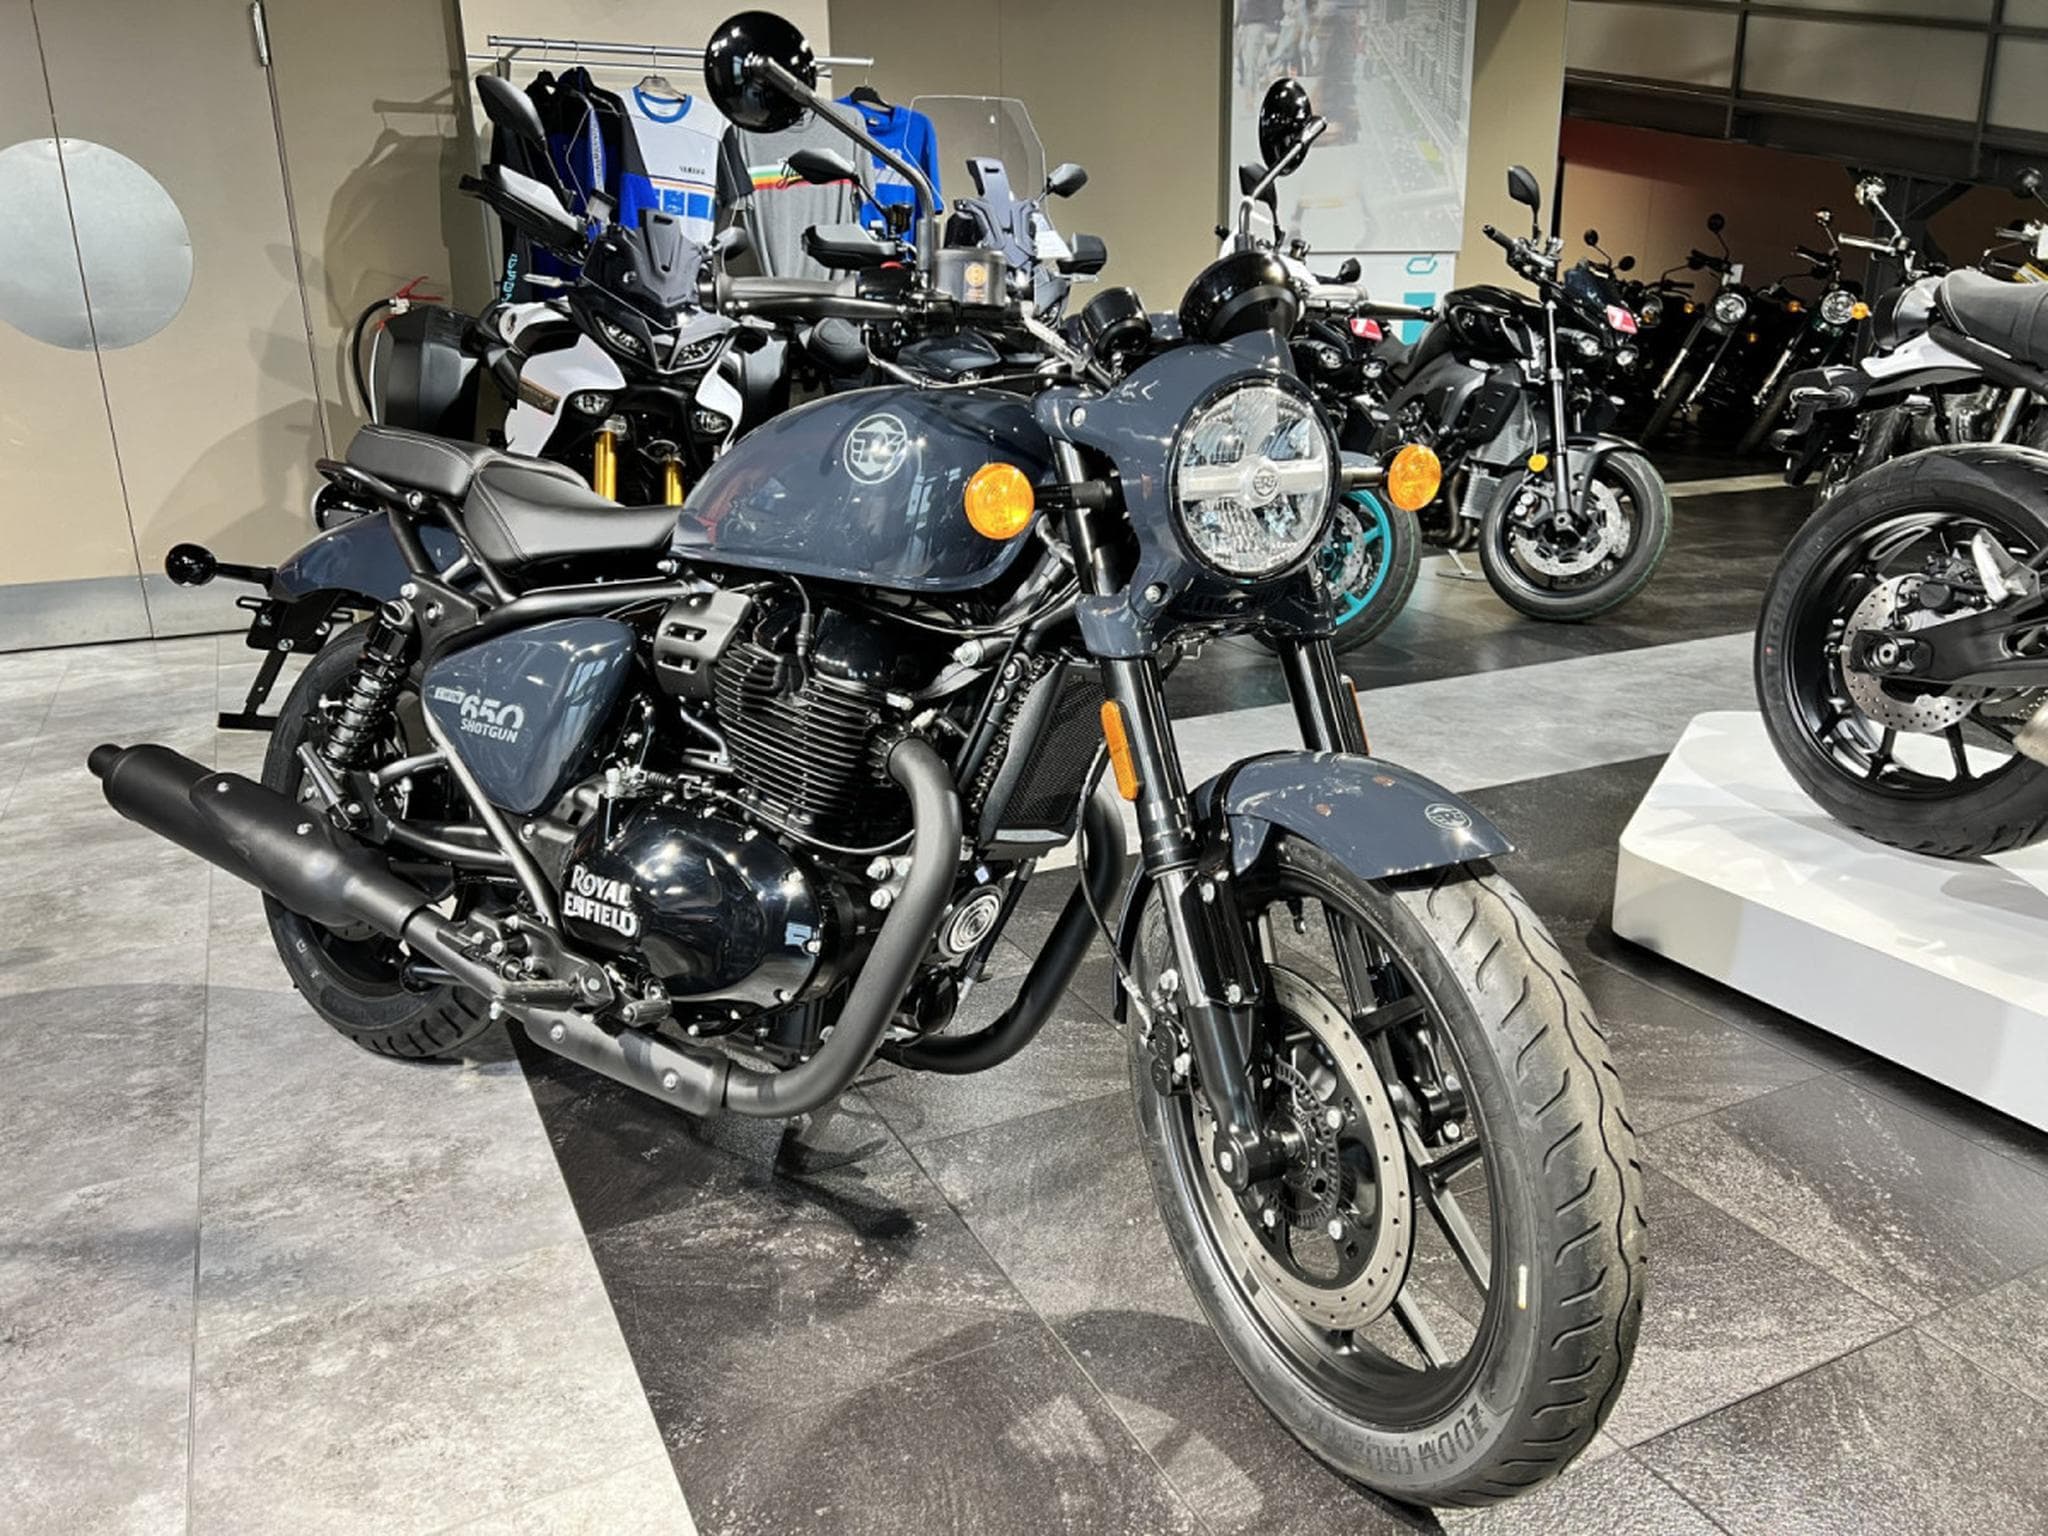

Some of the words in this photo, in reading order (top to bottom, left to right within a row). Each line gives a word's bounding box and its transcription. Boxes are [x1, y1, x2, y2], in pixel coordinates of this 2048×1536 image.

[460, 694, 525, 730] 650
[460, 718, 519, 744] SHOTGUN
[571, 864, 633, 907] ROYAL
[562, 890, 639, 937] ENFIELD
[1418, 1402, 1490, 1473] ZOOM
